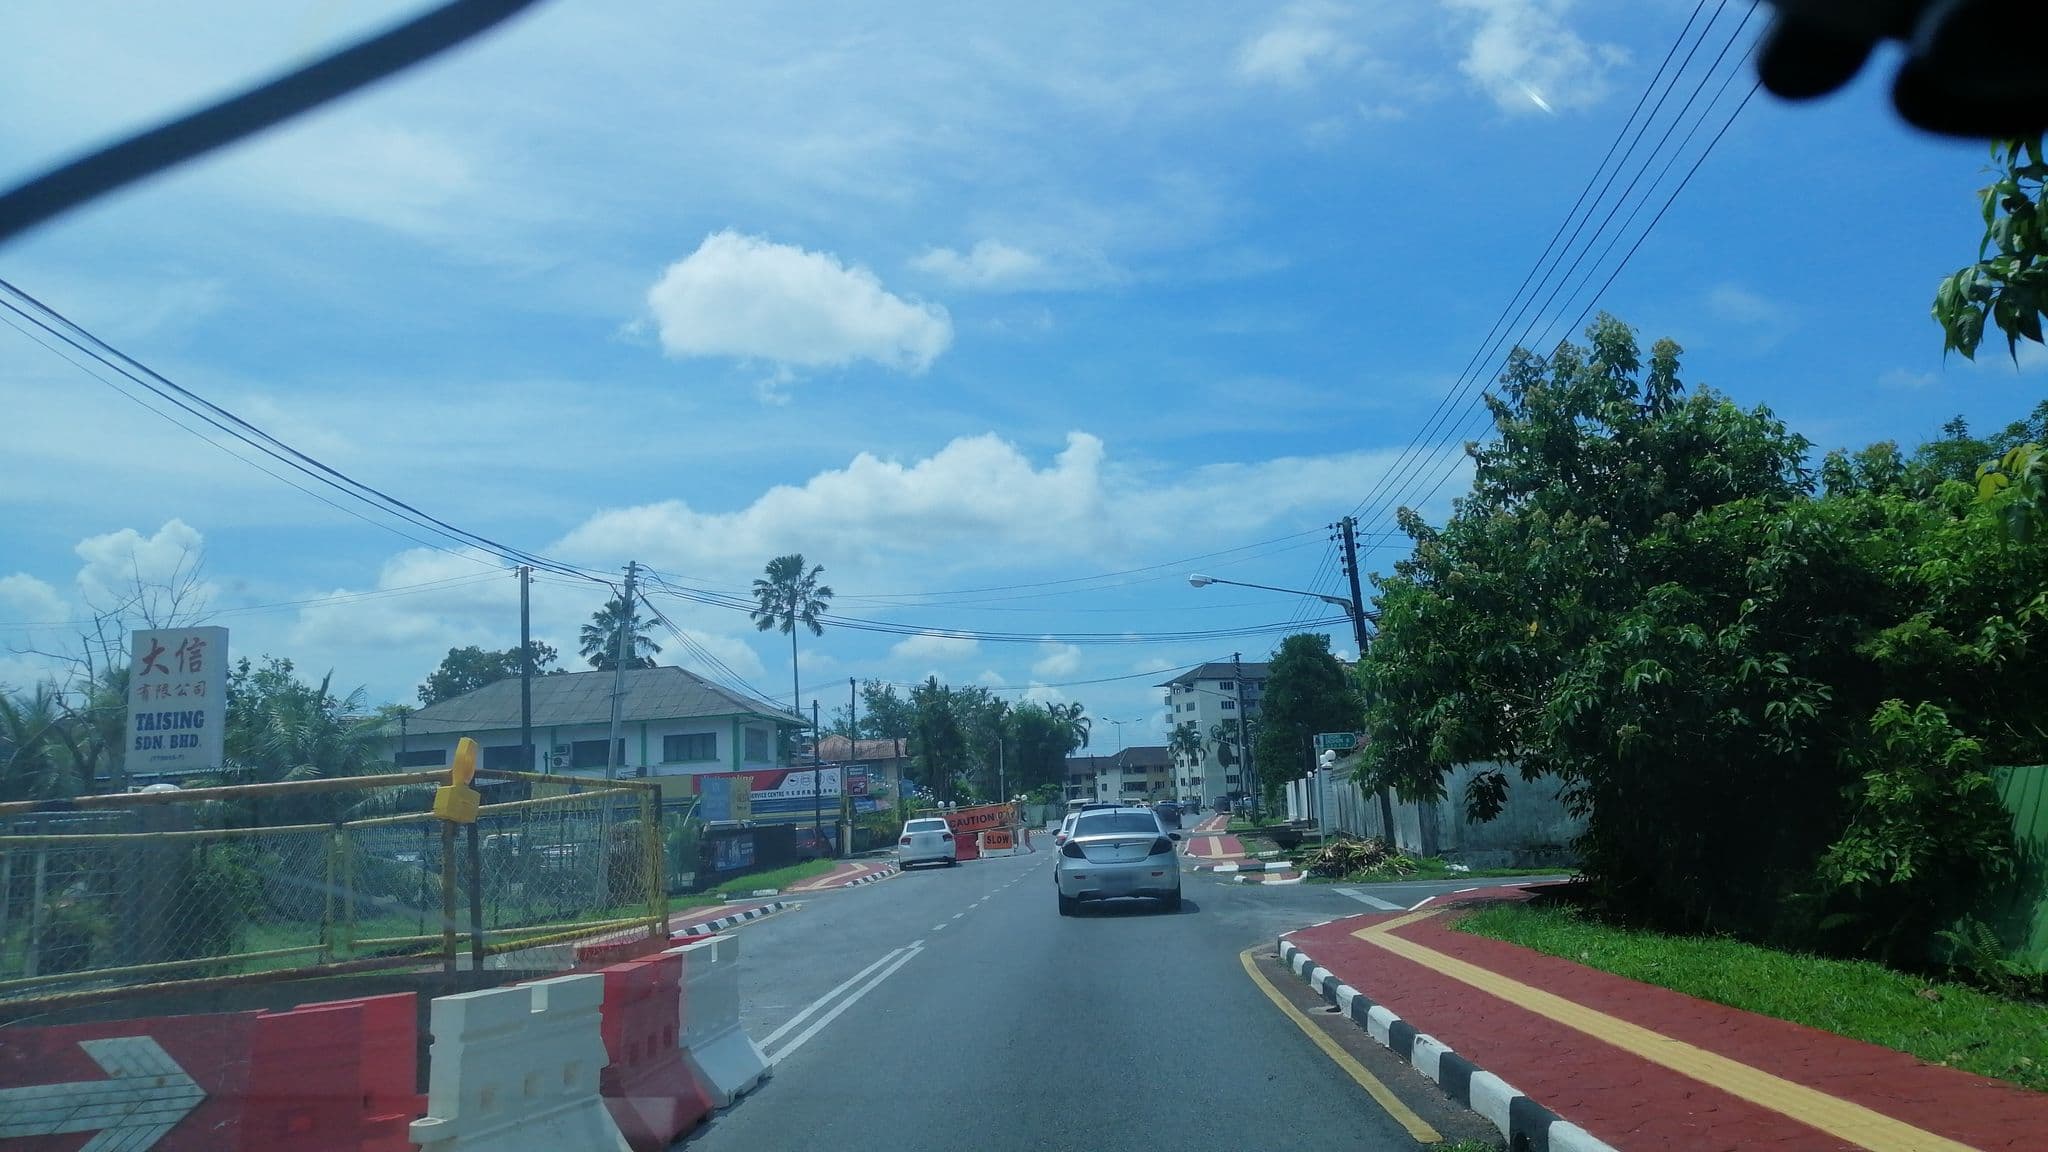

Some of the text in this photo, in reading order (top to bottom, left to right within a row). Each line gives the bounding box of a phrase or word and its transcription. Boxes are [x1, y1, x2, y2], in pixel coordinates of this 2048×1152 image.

[139, 637, 207, 676] 大信
[138, 680, 206, 701] 有限公司
[135, 710, 204, 732] TAISING
[951, 812, 995, 829] CAUTION
[986, 834, 1009, 845] SLOW
